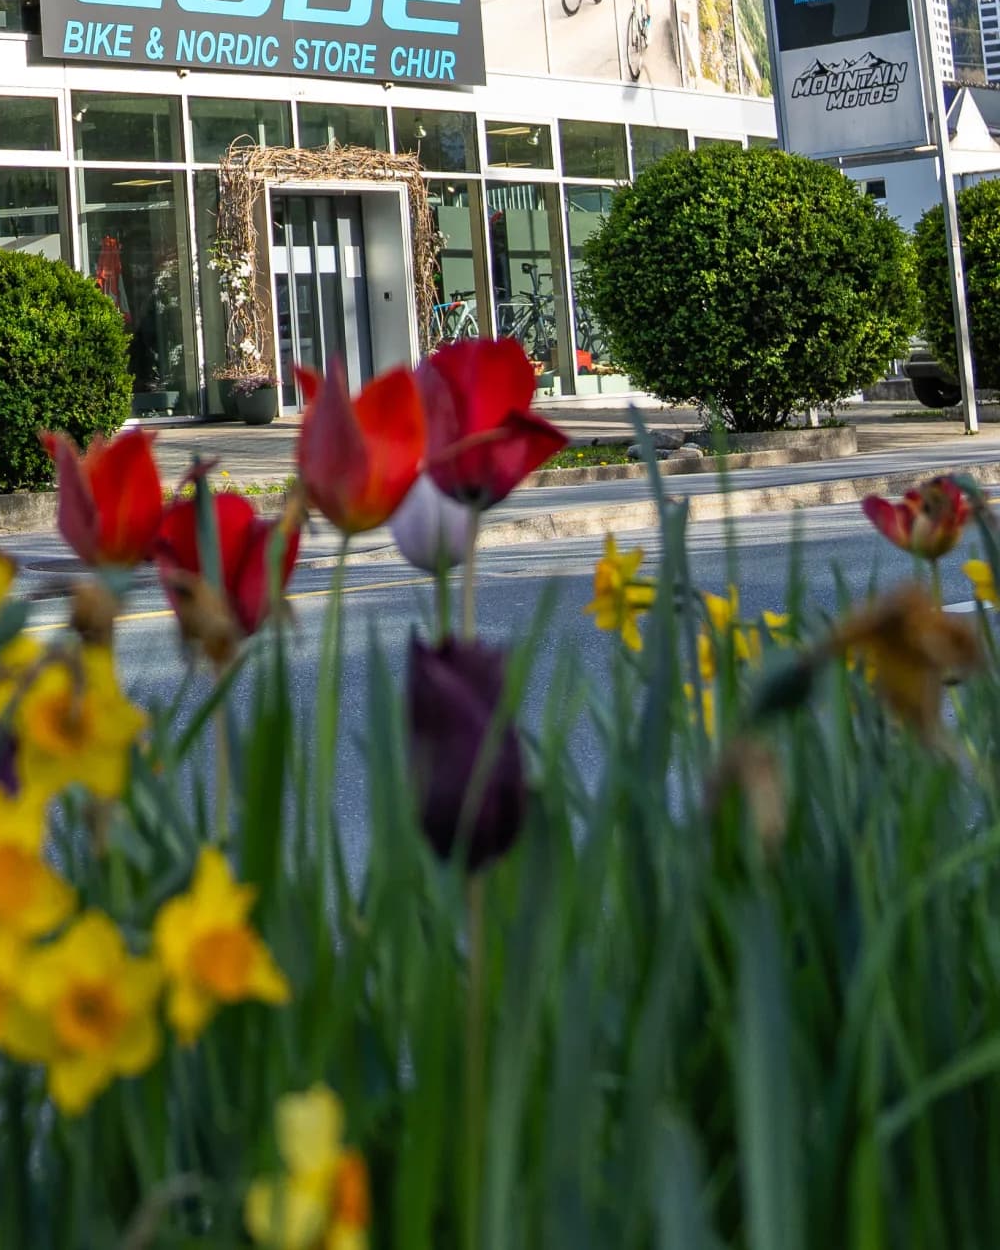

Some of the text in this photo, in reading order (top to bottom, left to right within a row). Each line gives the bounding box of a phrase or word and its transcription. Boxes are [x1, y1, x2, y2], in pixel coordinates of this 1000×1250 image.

[63, 21, 456, 80] BIKE & NORDIC STORE CHUR
[792, 61, 908, 99] MOUNTAIN
[826, 84, 898, 111] MOTOS
